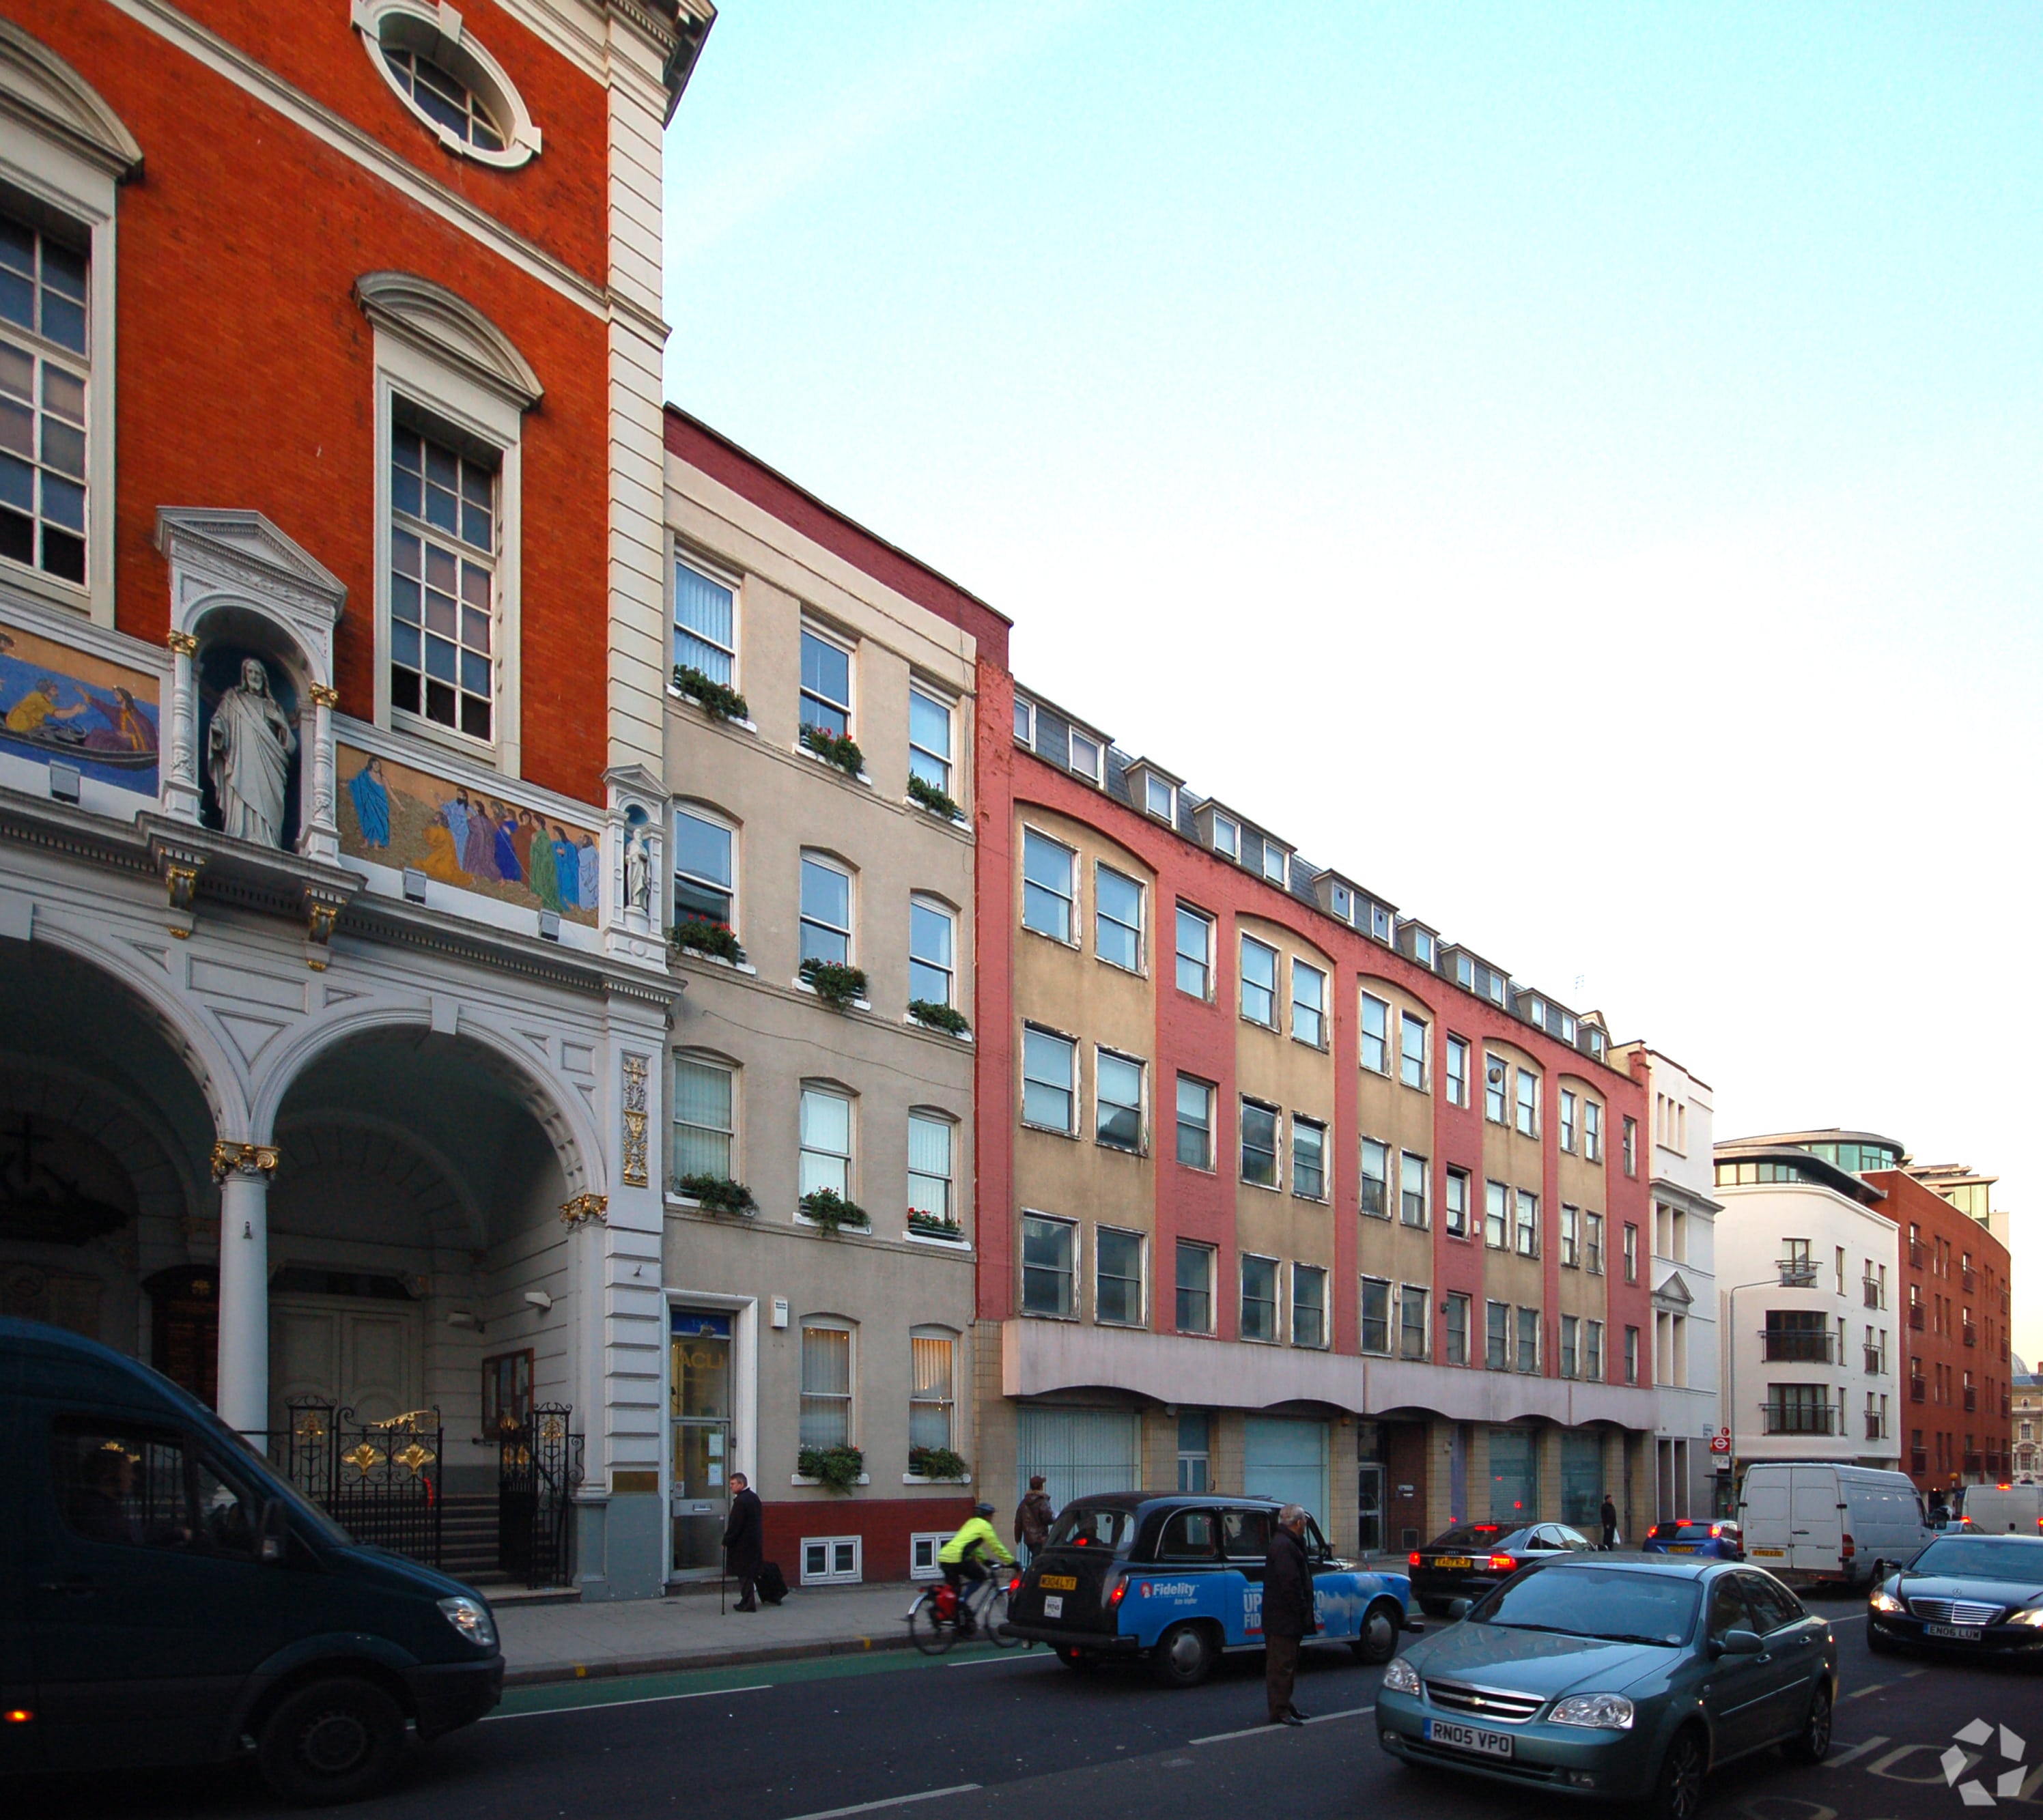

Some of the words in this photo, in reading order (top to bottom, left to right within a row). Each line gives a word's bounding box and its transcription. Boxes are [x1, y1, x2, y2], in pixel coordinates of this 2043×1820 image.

[1153, 1582, 1196, 1597] Fidelity
[1434, 1722, 1473, 1745] RN05
[1478, 1732, 1510, 1752] VPO
